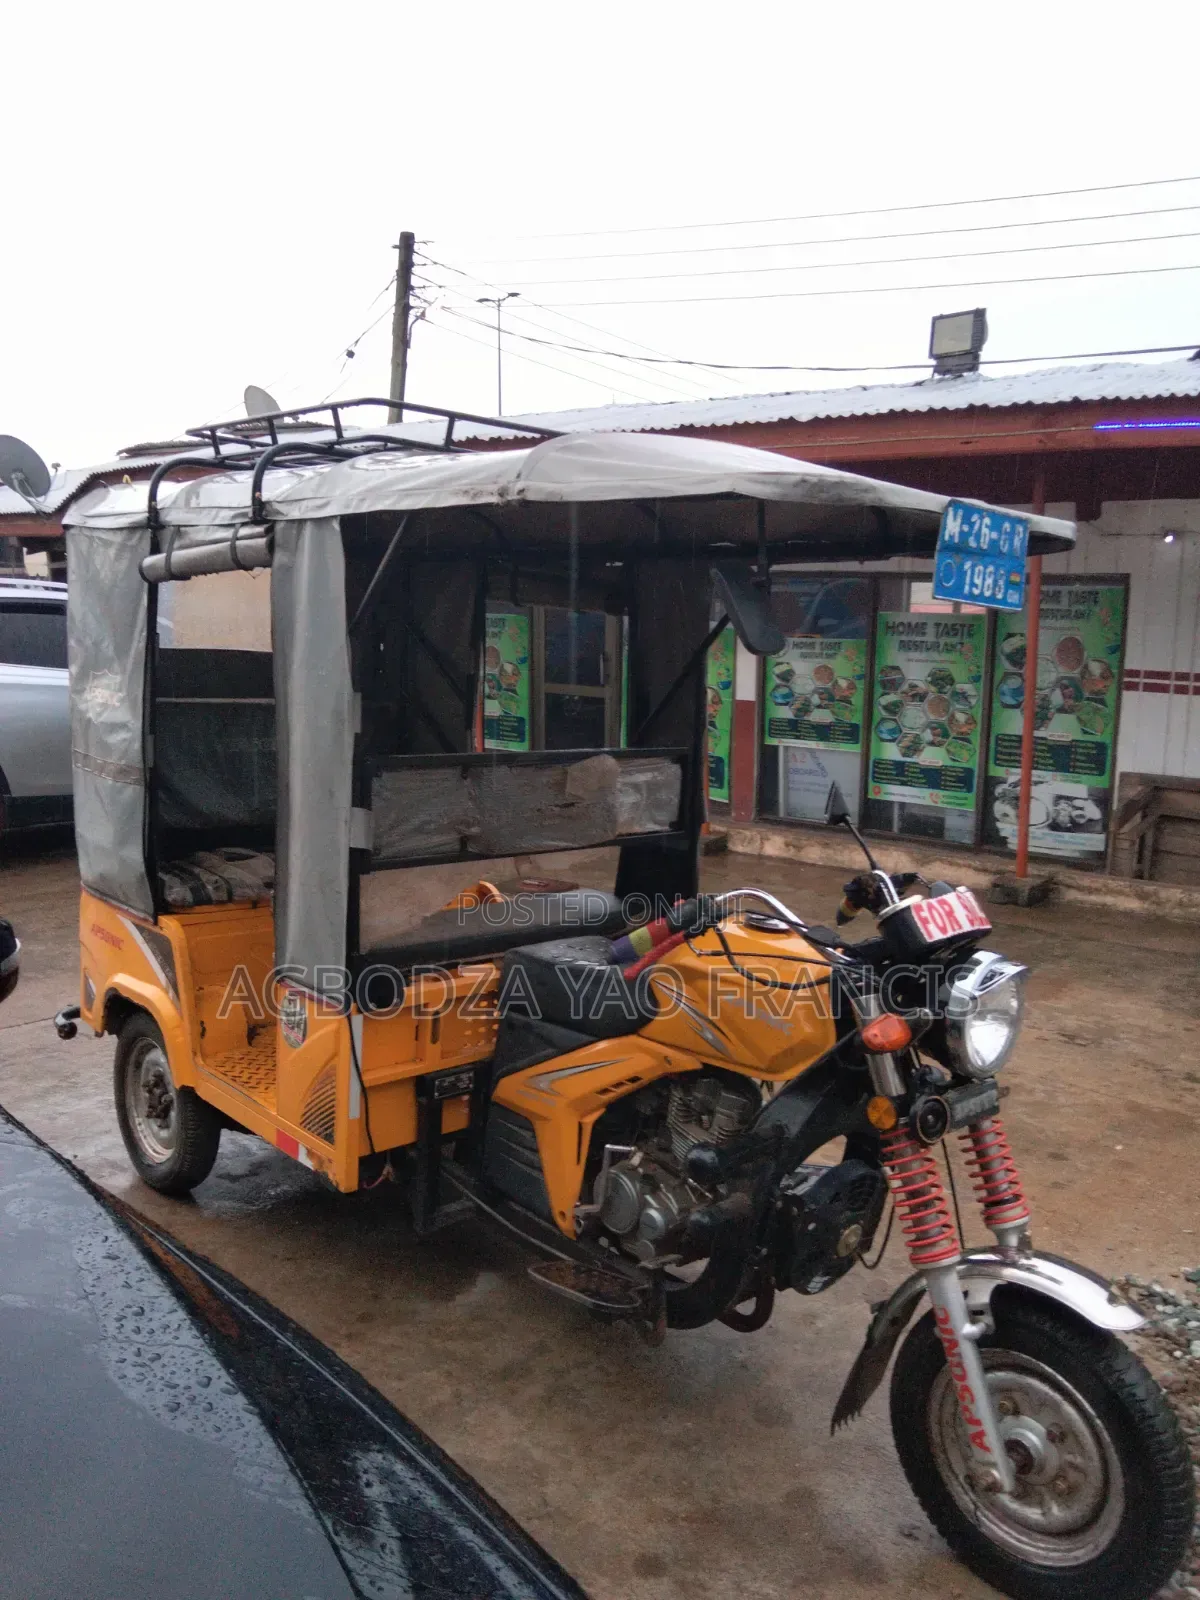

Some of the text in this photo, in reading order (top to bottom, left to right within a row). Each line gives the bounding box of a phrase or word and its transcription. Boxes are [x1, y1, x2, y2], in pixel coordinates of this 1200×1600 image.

[885, 621, 974, 639] HOME TASTE
[793, 641, 817, 651] HOME
[912, 898, 963, 940] FOR
[935, 1306, 992, 1454] APSONIC
